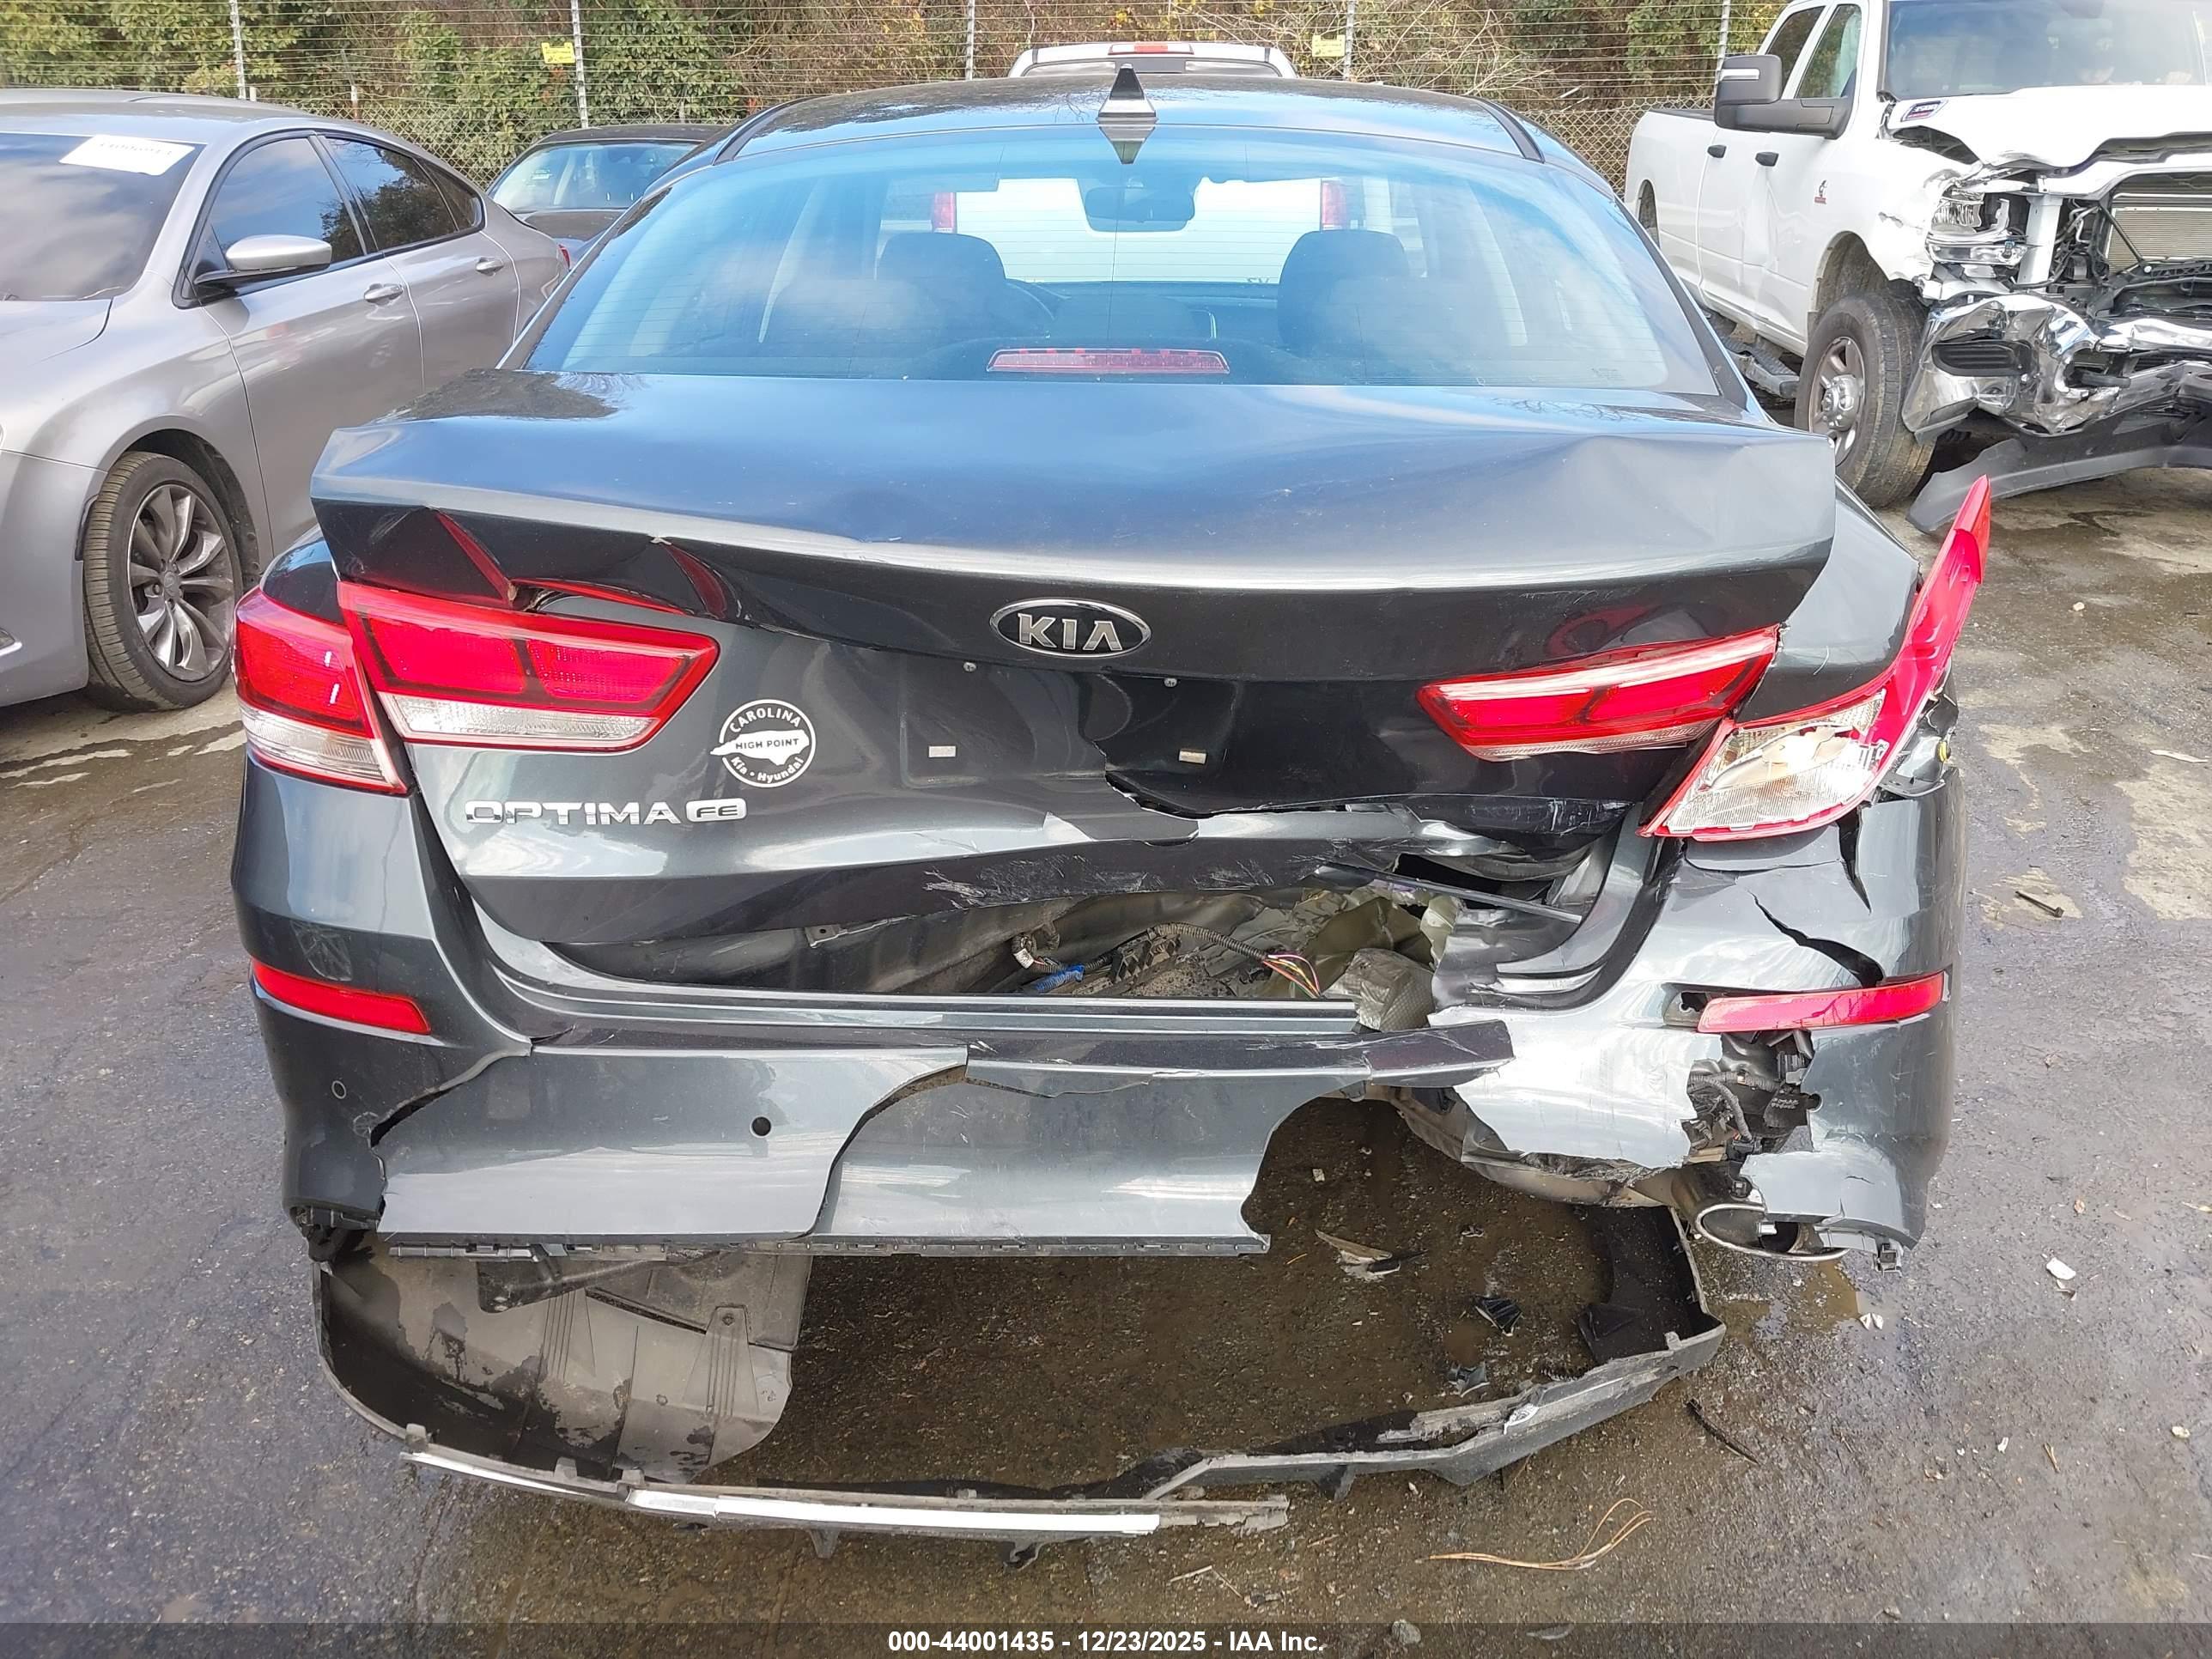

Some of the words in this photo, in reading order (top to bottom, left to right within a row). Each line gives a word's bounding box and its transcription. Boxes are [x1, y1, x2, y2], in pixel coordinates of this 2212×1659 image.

[1018, 613, 1123, 651] KIA
[729, 707, 802, 732] CAROLINA
[735, 740, 763, 750] HIGH
[766, 738, 799, 748] POINT
[730, 756, 748, 775] Kia
[757, 757, 805, 784] Hyundai
[465, 800, 682, 825] OPTIMA
[696, 804, 738, 818] FE
